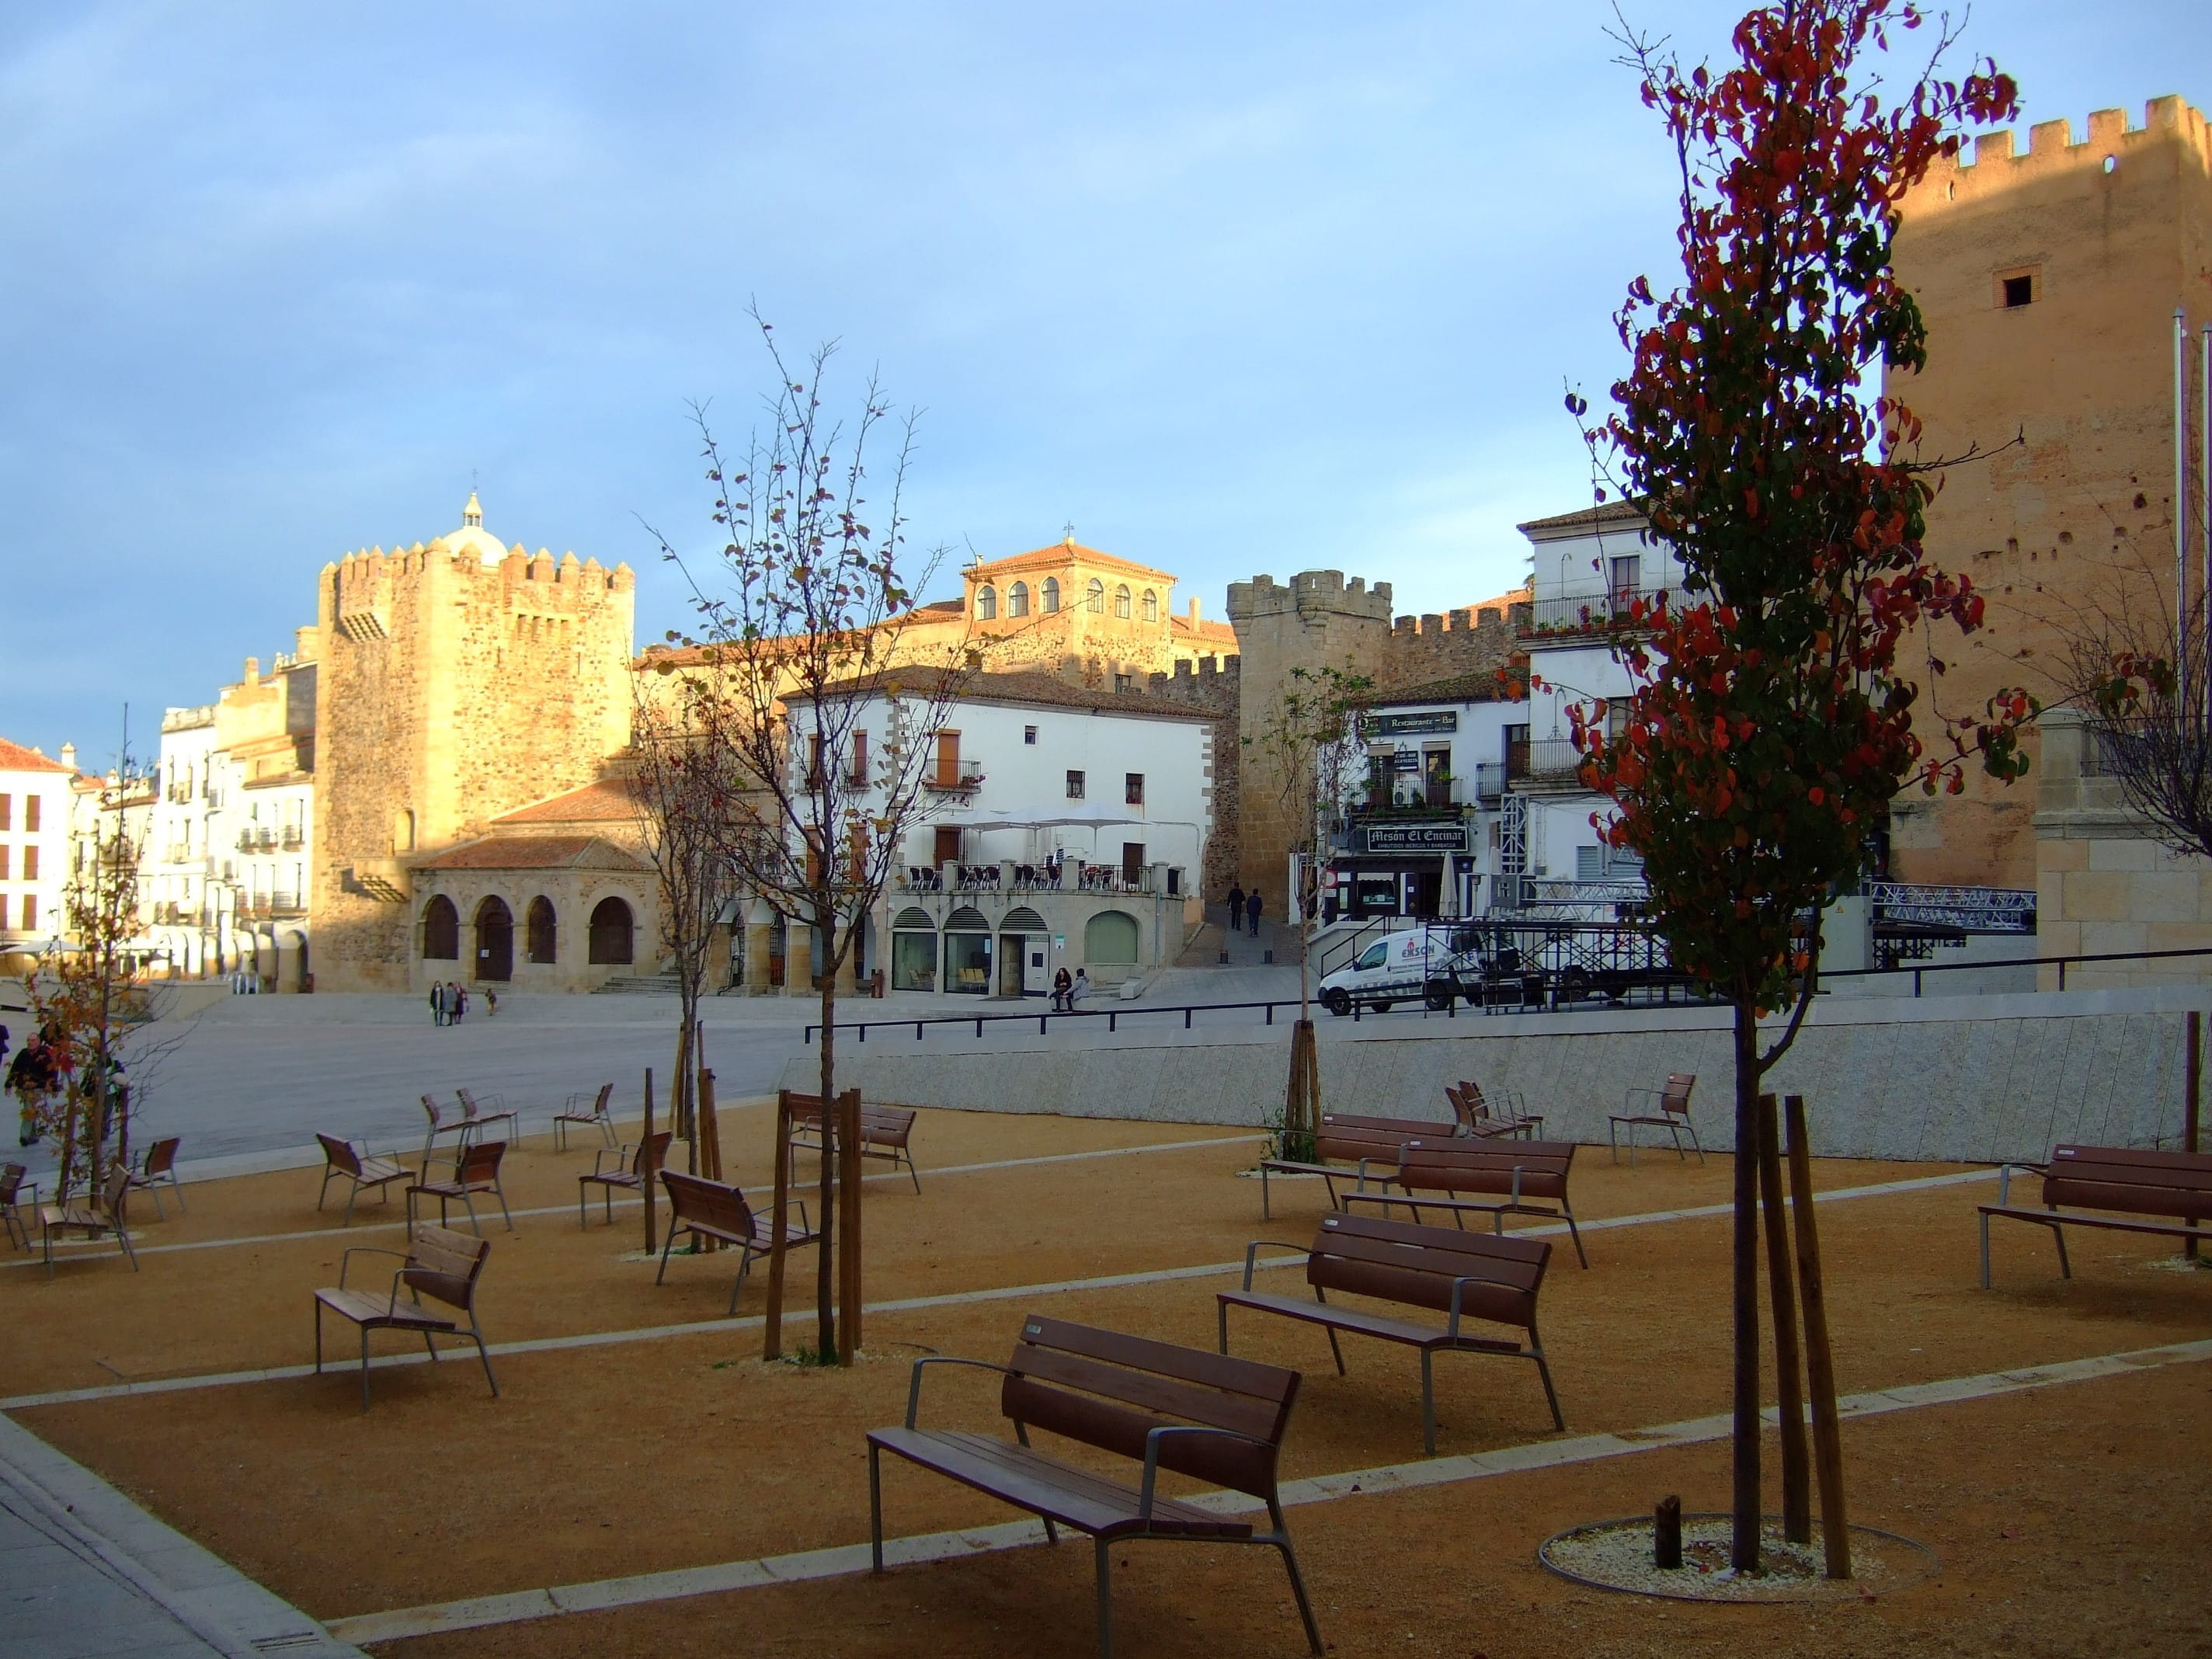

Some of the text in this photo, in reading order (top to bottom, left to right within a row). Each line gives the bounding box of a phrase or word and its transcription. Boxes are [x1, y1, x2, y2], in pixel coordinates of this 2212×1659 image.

[1391, 718, 1433, 728] Restaurante
[1442, 715, 1455, 724] Bar
[1371, 830, 1462, 842] Mesón El Encinar
